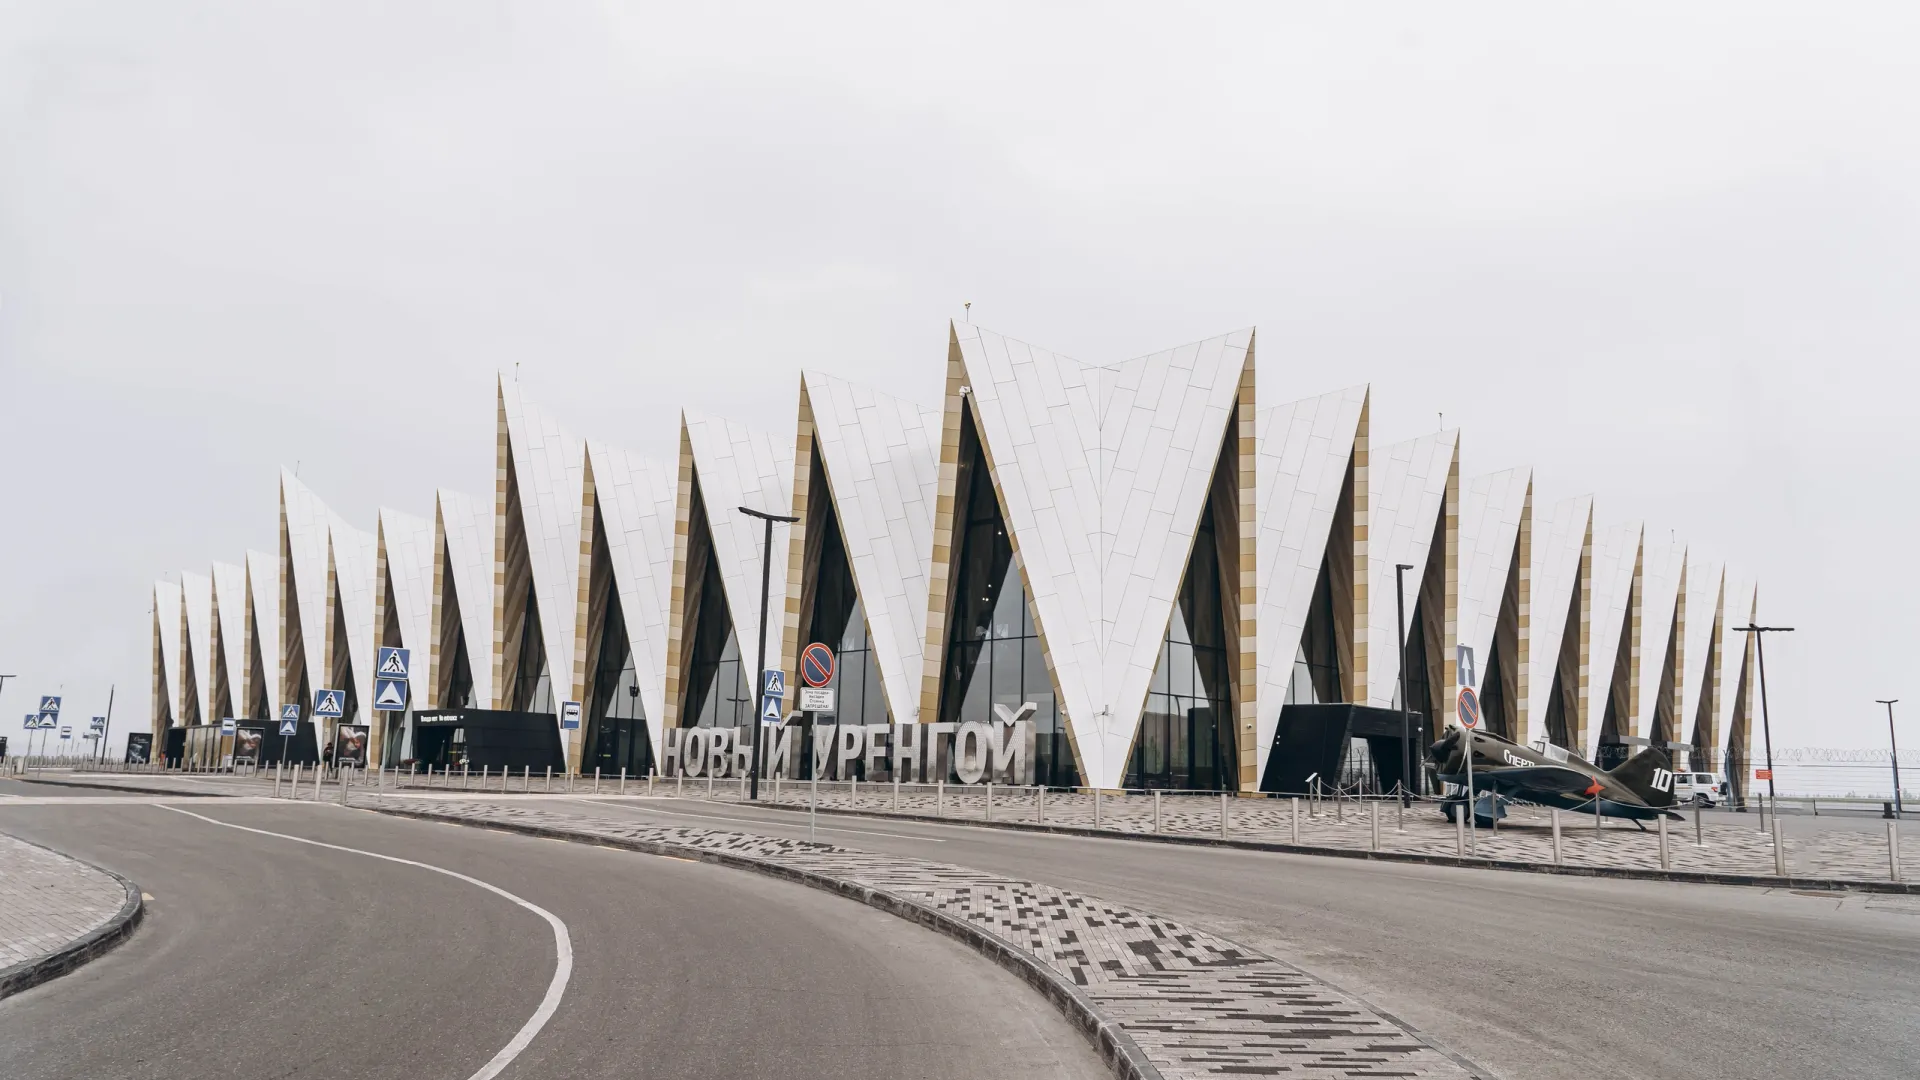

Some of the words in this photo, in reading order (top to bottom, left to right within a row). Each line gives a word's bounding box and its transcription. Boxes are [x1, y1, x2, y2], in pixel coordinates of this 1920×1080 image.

[663, 711, 800, 779] НОВЫЙ
[813, 702, 1037, 785] УРЕНГОЙ
[1650, 767, 1673, 792] 10
